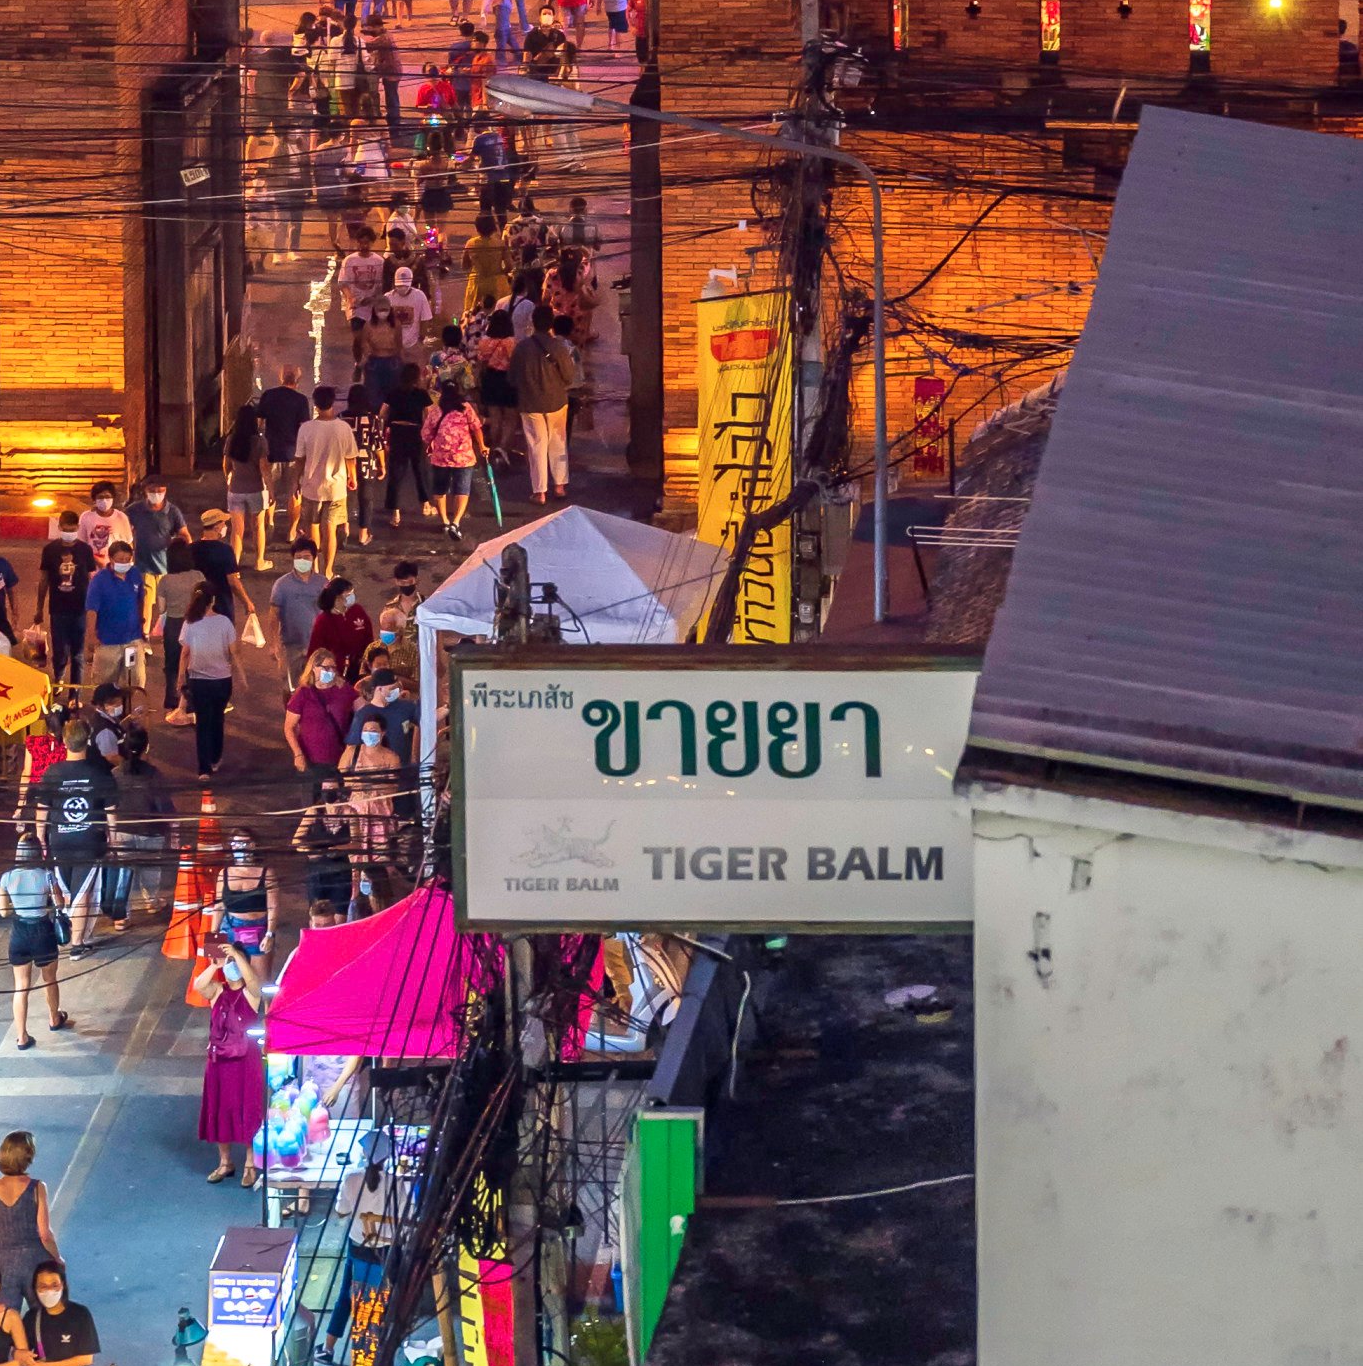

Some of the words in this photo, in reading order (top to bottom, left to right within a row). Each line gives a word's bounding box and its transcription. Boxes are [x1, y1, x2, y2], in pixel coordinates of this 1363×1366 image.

[469, 681, 574, 710] พีระเภสัช
[581, 698, 883, 779] ขายยา
[642, 845, 789, 882] TIGER
[806, 845, 945, 882] BALM
[504, 877, 559, 892] TIGER
[565, 876, 620, 892] BALM
